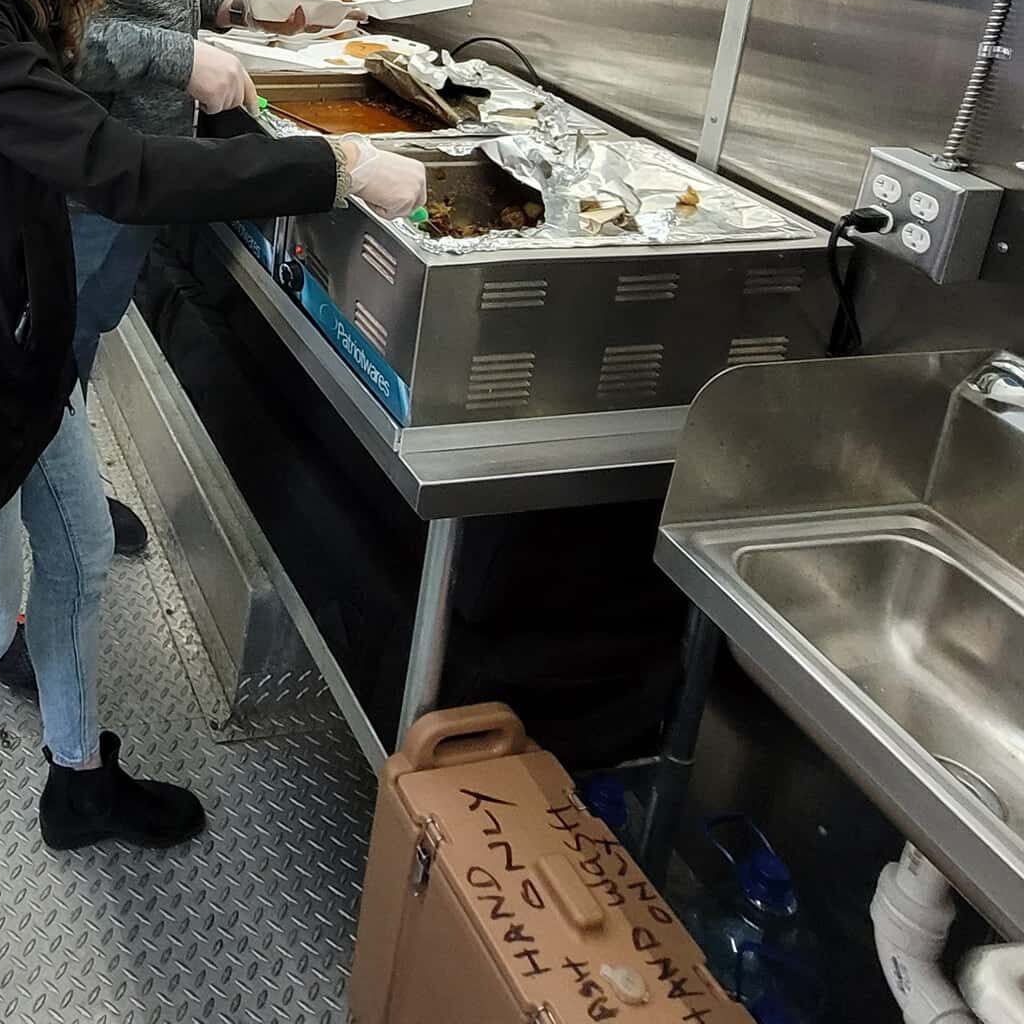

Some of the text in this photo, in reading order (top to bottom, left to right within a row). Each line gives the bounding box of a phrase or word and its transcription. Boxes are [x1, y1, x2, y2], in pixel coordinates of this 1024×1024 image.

[460, 788, 619, 1023] ASH ONLY
[467, 866, 551, 978] HAND
[594, 838, 673, 923] ONLY
